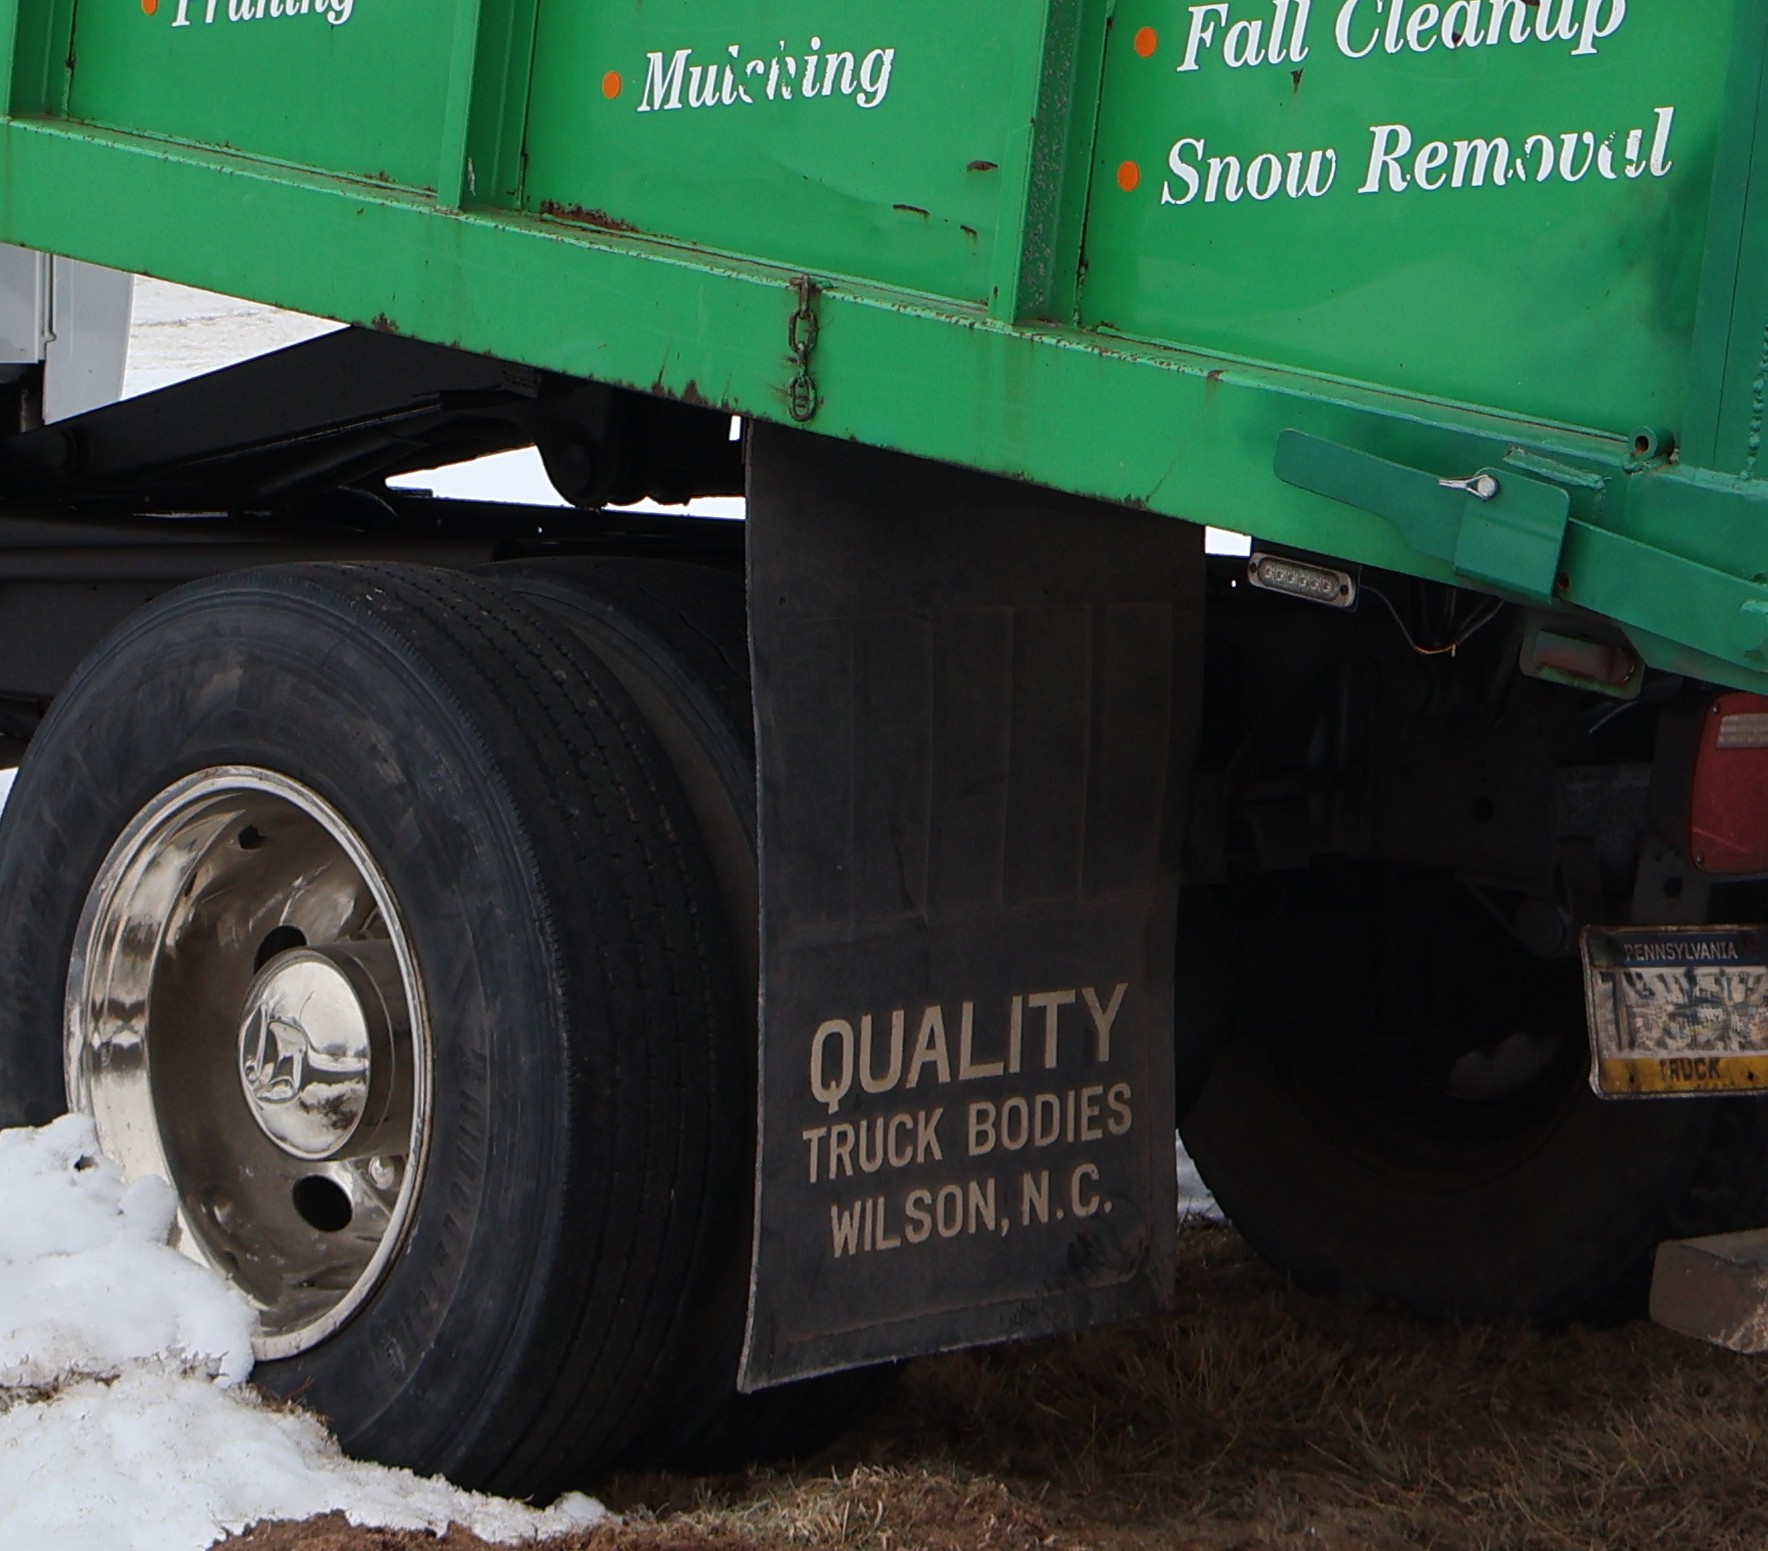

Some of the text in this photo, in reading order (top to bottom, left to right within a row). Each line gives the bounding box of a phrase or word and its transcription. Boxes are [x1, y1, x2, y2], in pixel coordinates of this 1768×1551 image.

[1161, 106, 1674, 205] Snow Removal
[1624, 942, 1739, 962] PENNSYLVANIA
[810, 983, 1128, 1114] QUALITY
[1659, 1058, 1721, 1080] TRUCK
[802, 1083, 1132, 1183] TRUCK BODIES
[831, 1178, 1009, 1258] WILSON,
